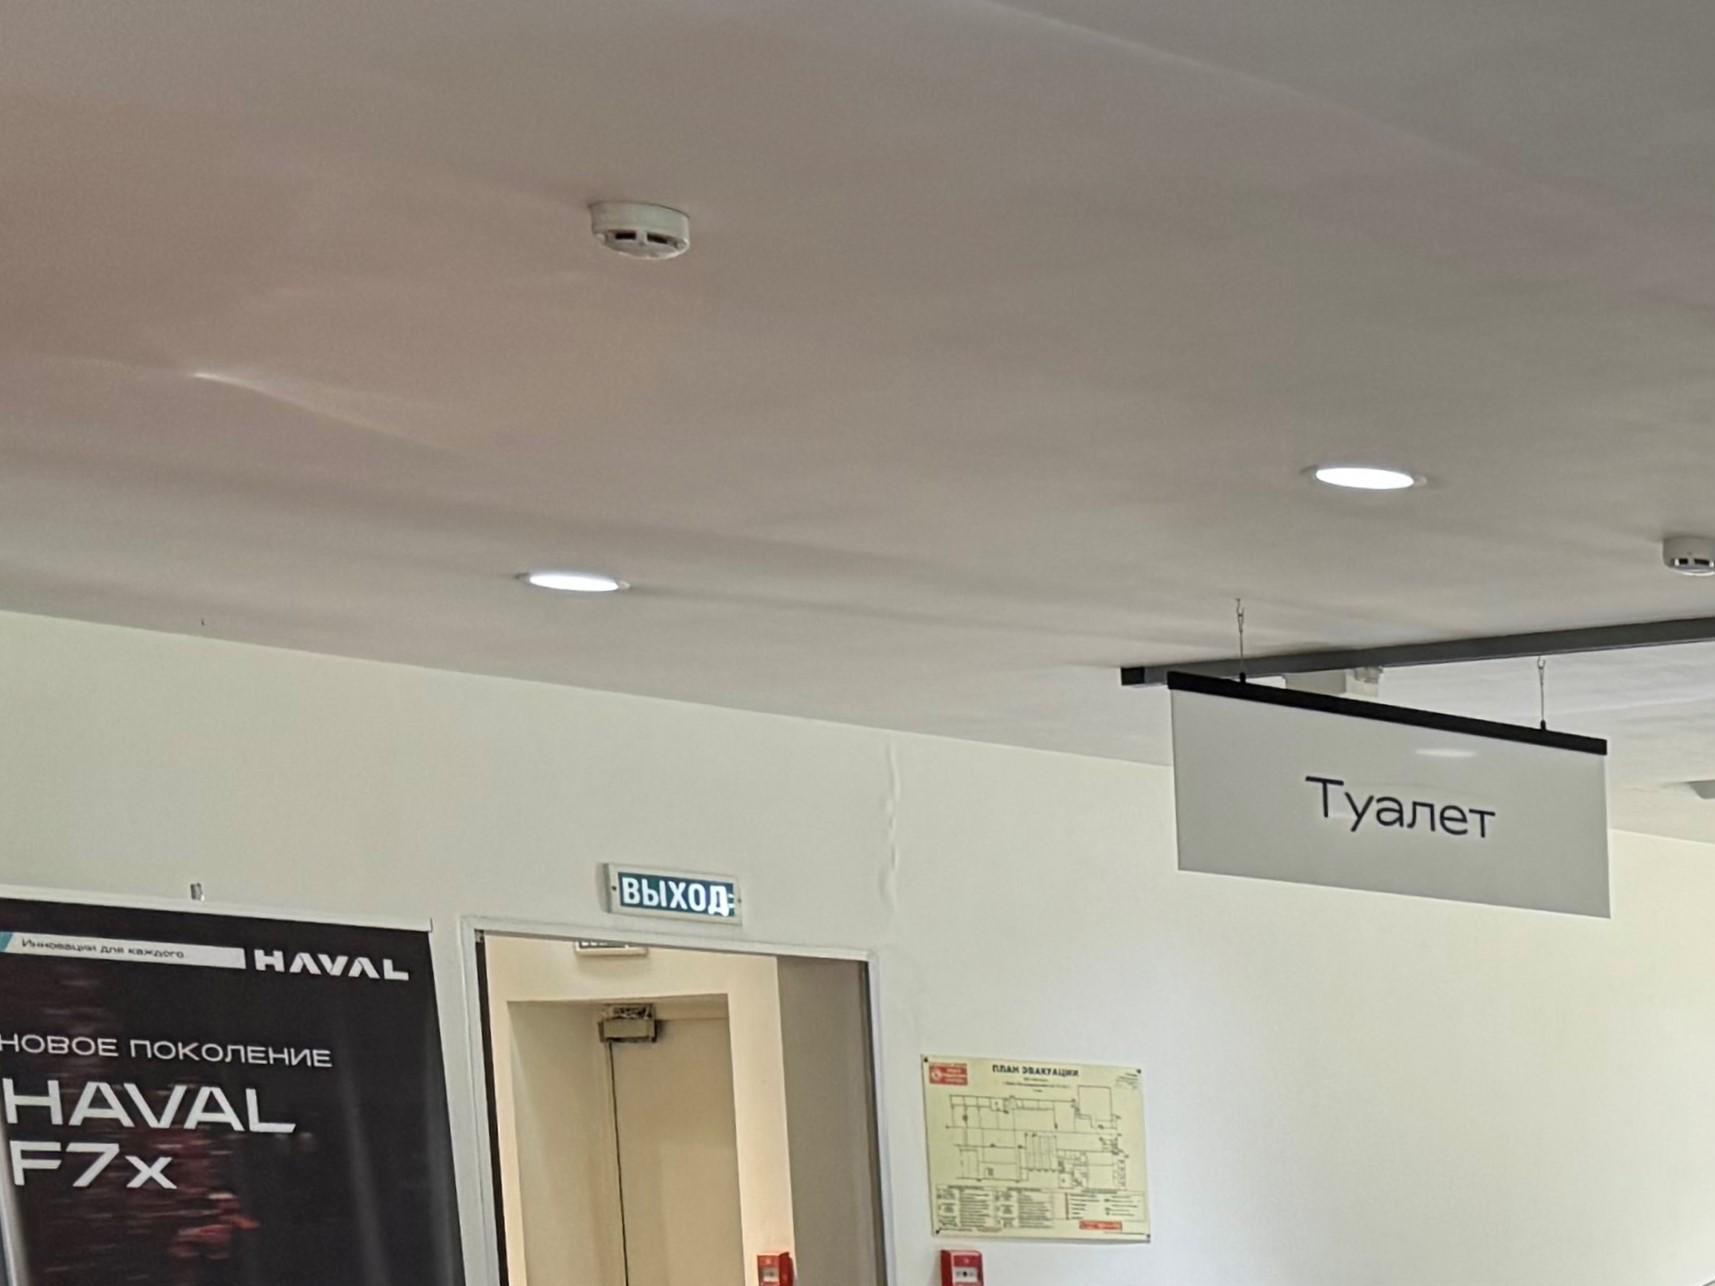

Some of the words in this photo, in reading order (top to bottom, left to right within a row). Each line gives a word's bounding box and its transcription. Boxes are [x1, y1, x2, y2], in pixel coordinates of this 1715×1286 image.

[1305, 775, 1496, 838] Туалет
[621, 876, 731, 917] ВЫХОД
[254, 949, 409, 981] HAVAL
[0, 1033, 119, 1057] НОВОЕ
[130, 1039, 333, 1068] ПОКОЛЕНИЕ
[2, 1077, 297, 1133] HAVAL
[9, 1139, 178, 1190] F7x
